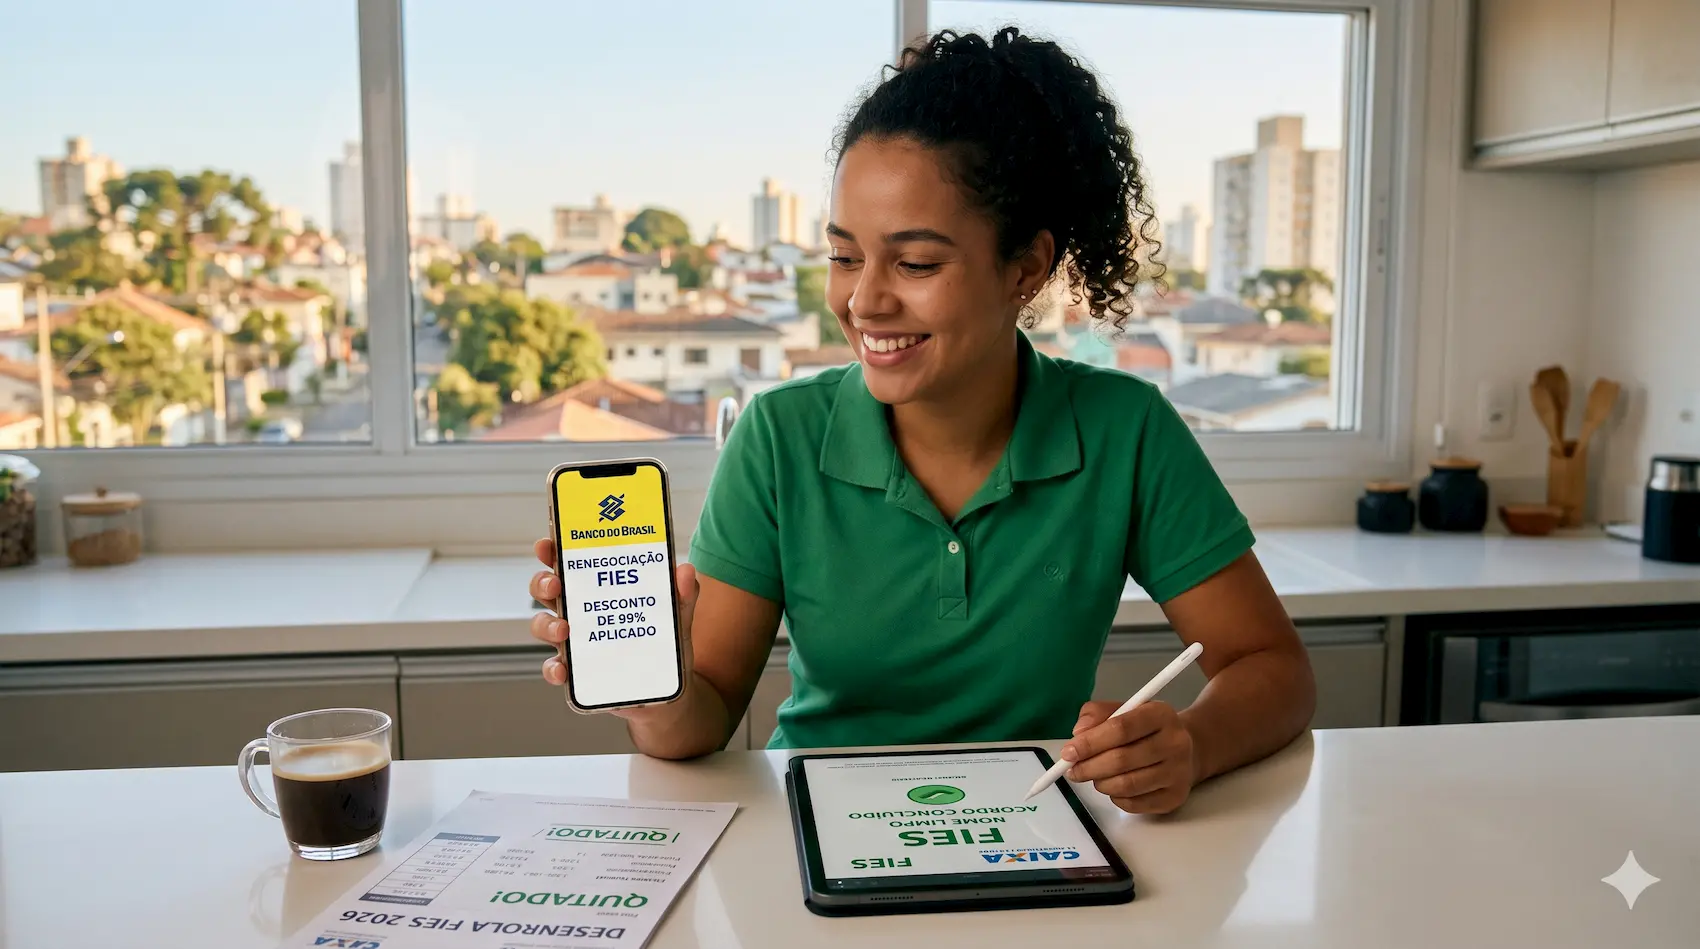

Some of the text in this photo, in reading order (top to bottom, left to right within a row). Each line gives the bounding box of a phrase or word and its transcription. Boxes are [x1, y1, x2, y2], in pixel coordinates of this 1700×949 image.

[571, 525, 656, 540] BANCO DO BRASIL
[568, 552, 664, 570] RENEGOCIAÇÃO
[597, 569, 639, 587] FIES
[584, 596, 656, 613] DESCONTO
[597, 612, 646, 627] DE 99%
[589, 625, 656, 642] APLICADO
[848, 805, 1038, 820] ACORDO CONCLUÍDO
[889, 816, 1006, 828] NOME LIMPO
[547, 826, 667, 843] QUITADO!
[898, 827, 1005, 847] FIES
[851, 857, 912, 869] FIES
[981, 850, 1080, 864] CAIXA
[490, 890, 648, 908] QUITADO!
[339, 910, 626, 939] DESENROLA FIES 2026
